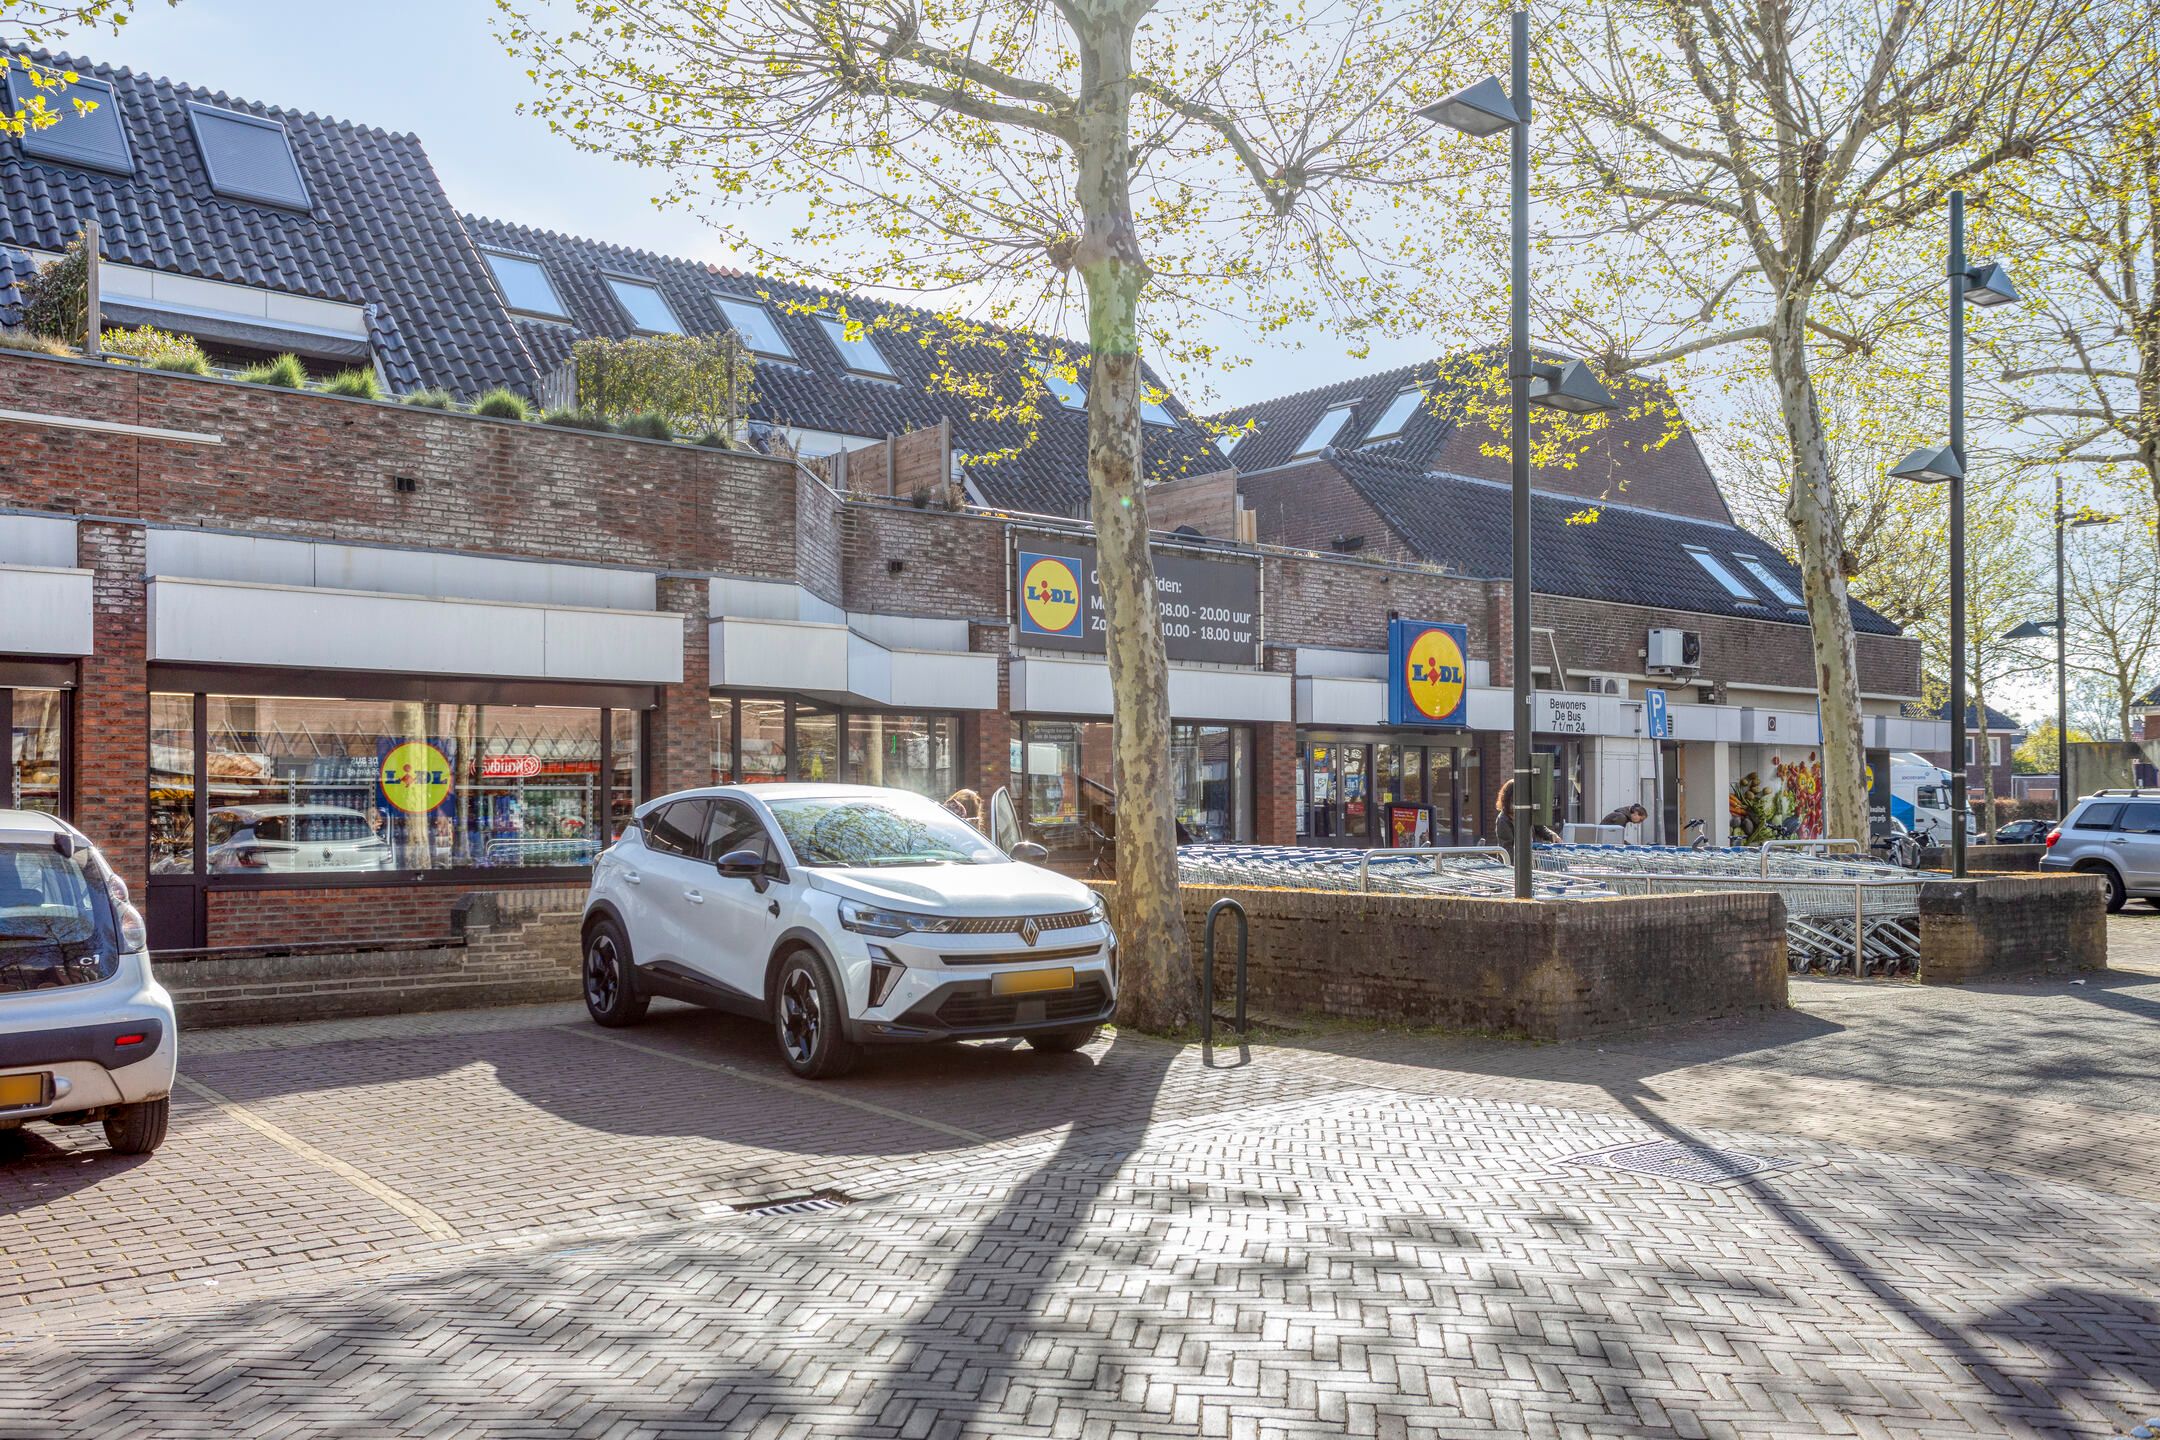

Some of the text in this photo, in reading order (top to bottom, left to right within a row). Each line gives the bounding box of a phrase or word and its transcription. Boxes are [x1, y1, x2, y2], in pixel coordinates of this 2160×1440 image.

[1160, 602, 1189, 618] 08.00
[1200, 606, 1230, 622] 20.00
[1233, 612, 1251, 625] uur
[1201, 626, 1230, 641] 18.00
[1233, 631, 1251, 644] uur
[1550, 698, 1587, 710] Bewoners
[1652, 693, 1662, 717] P
[1555, 710, 1582, 722] De Bus
[1552, 721, 1586, 733] 7 t/m 24
